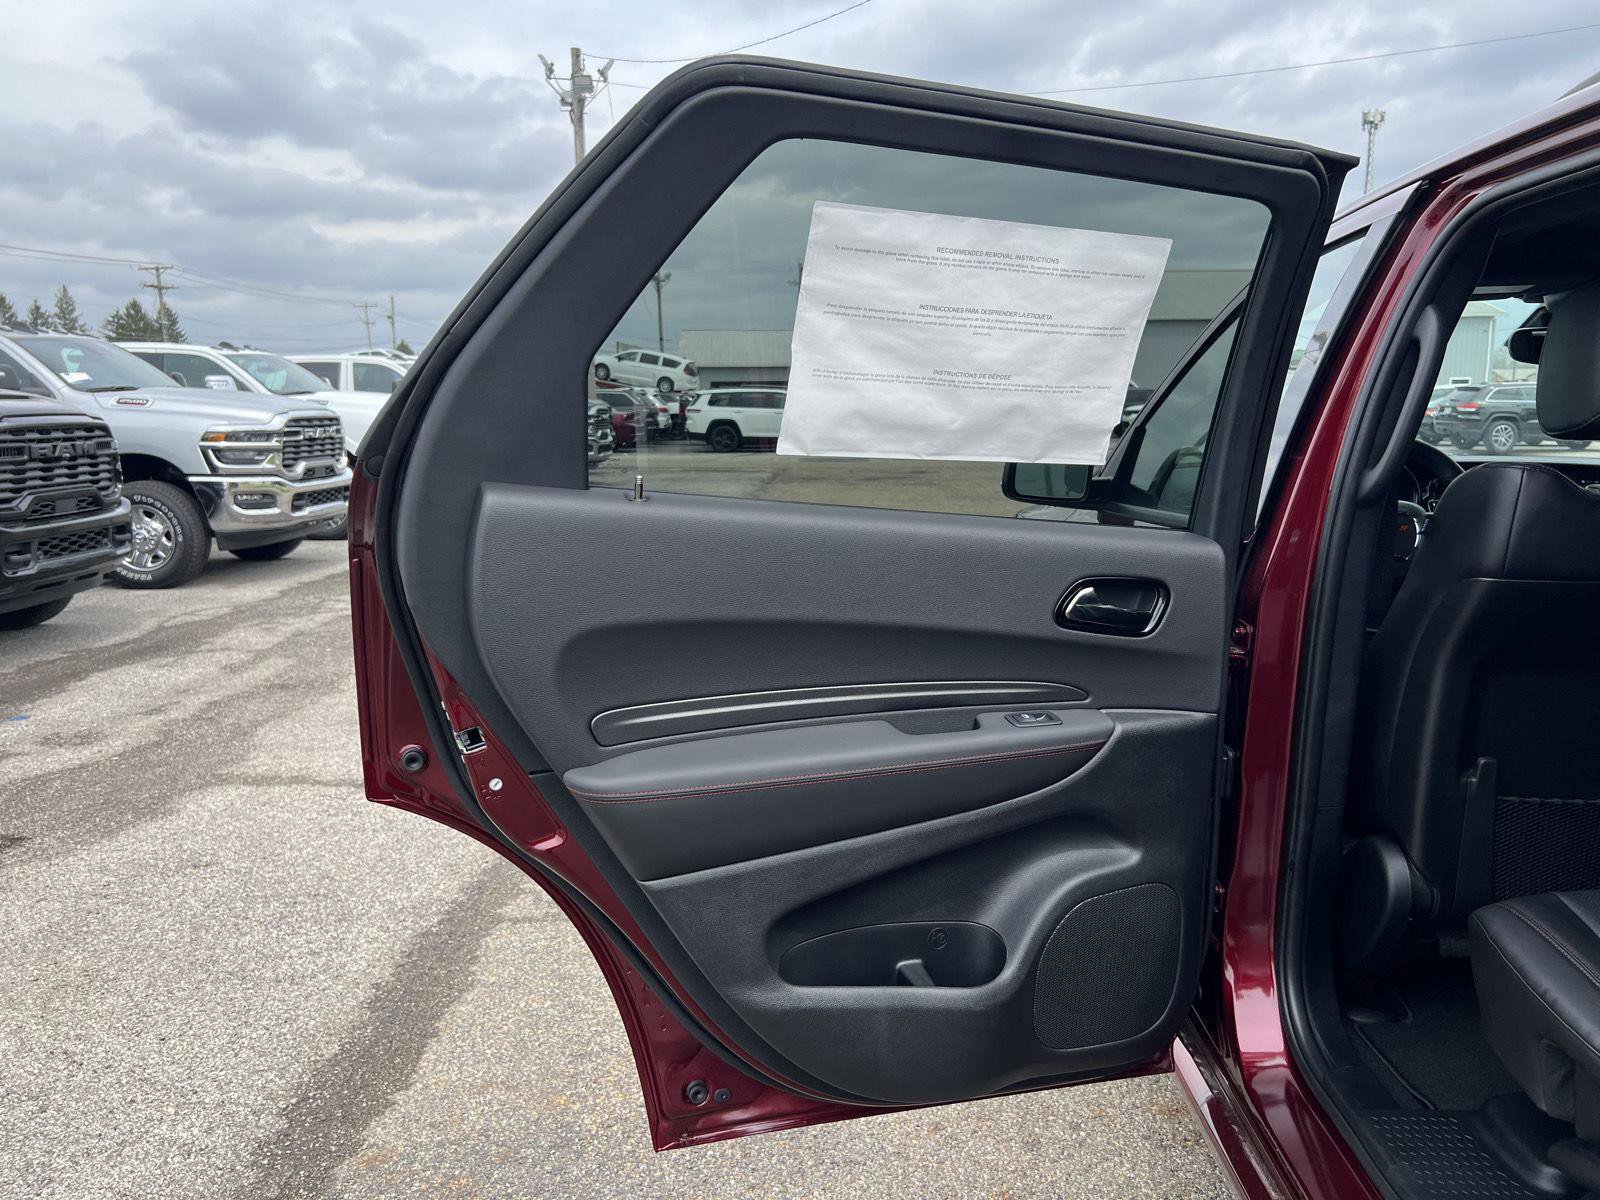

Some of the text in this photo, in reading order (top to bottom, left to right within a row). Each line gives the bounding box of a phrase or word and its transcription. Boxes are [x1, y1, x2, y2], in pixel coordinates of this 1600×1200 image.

[936, 246, 1060, 264] RECOMMENDED REMOVAL INSTRUCTIONS
[919, 304, 964, 313] INSTRUCCIONES
[980, 309, 1018, 317] DESPRENDER
[1027, 312, 1053, 320] ETIQUETA
[932, 369, 977, 379] INSTRUCTIONS
[988, 371, 1012, 380] DÉPOSE
[304, 425, 337, 439] RAM
[31, 441, 97, 459] RAM
